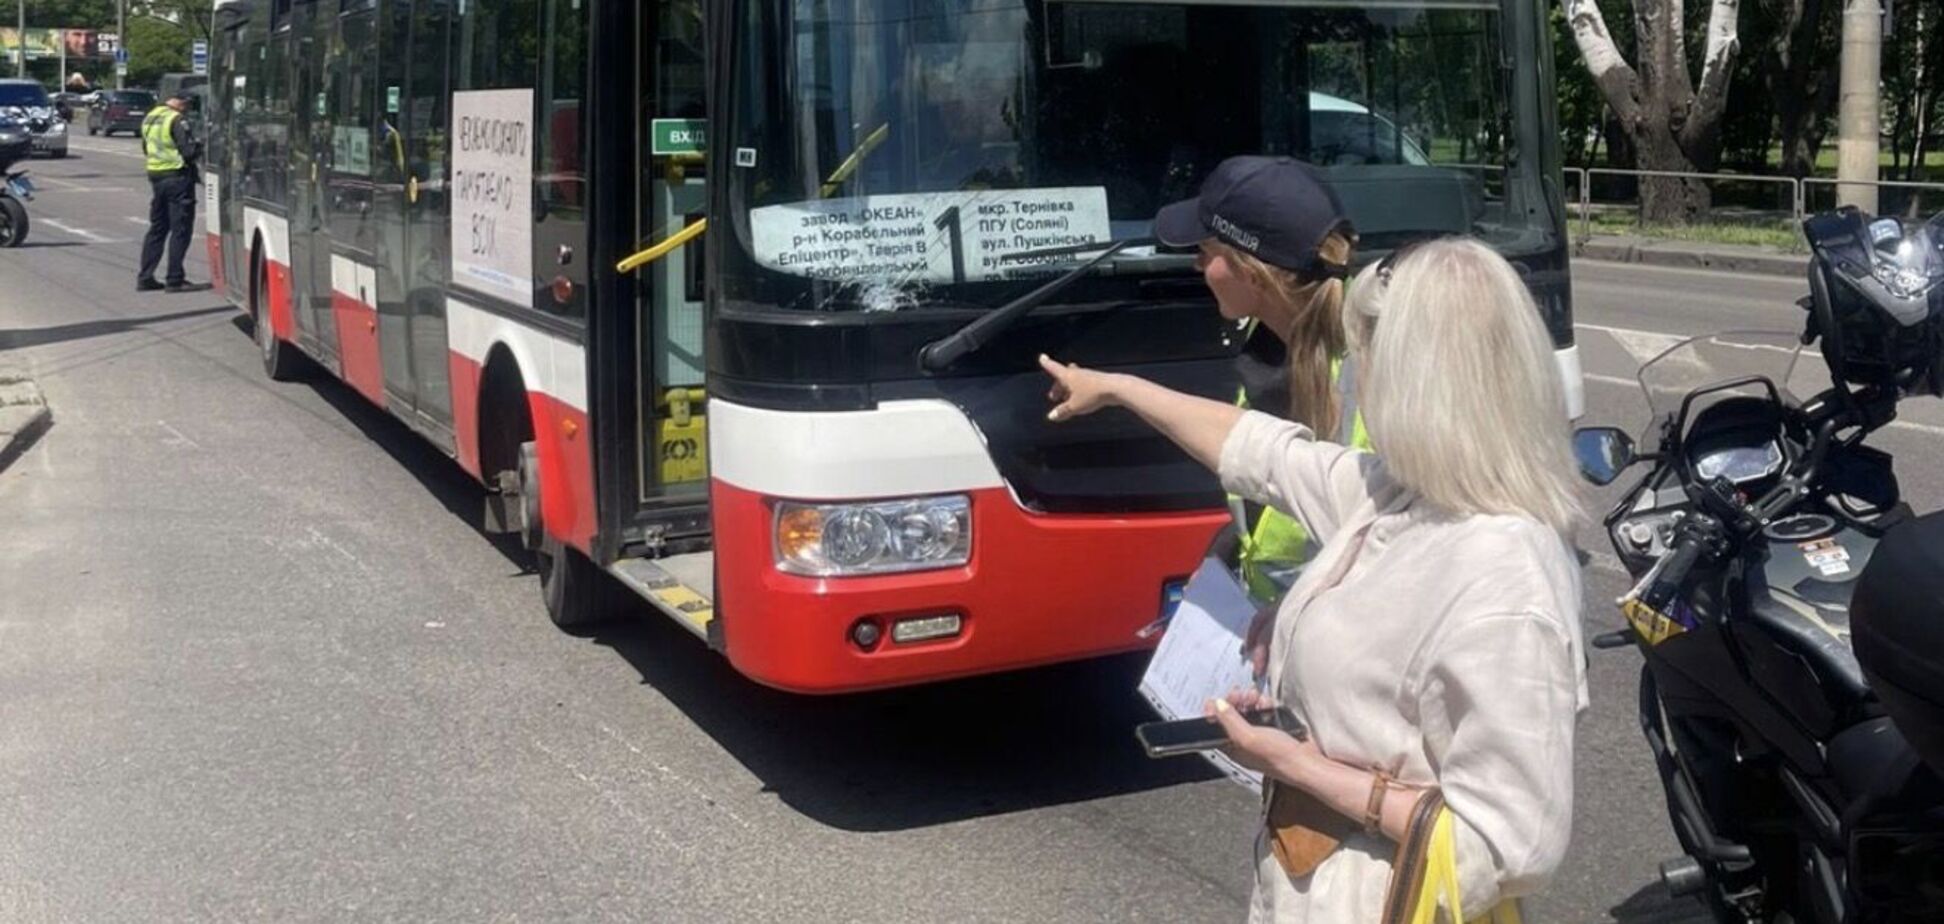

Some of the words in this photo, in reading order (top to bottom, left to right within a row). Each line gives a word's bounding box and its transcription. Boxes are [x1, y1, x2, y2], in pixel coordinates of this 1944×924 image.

[1013, 200, 1075, 215] Тернівка
[801, 212, 848, 227] завод
[979, 219, 1007, 233] ПГУ
[1011, 218, 1070, 234] (Соляні)
[793, 234, 818, 249] р-н
[821, 223, 925, 243] Корабельний
[933, 205, 967, 283] 1
[981, 238, 1011, 251] вул.
[1013, 233, 1097, 249] Пушкінська
